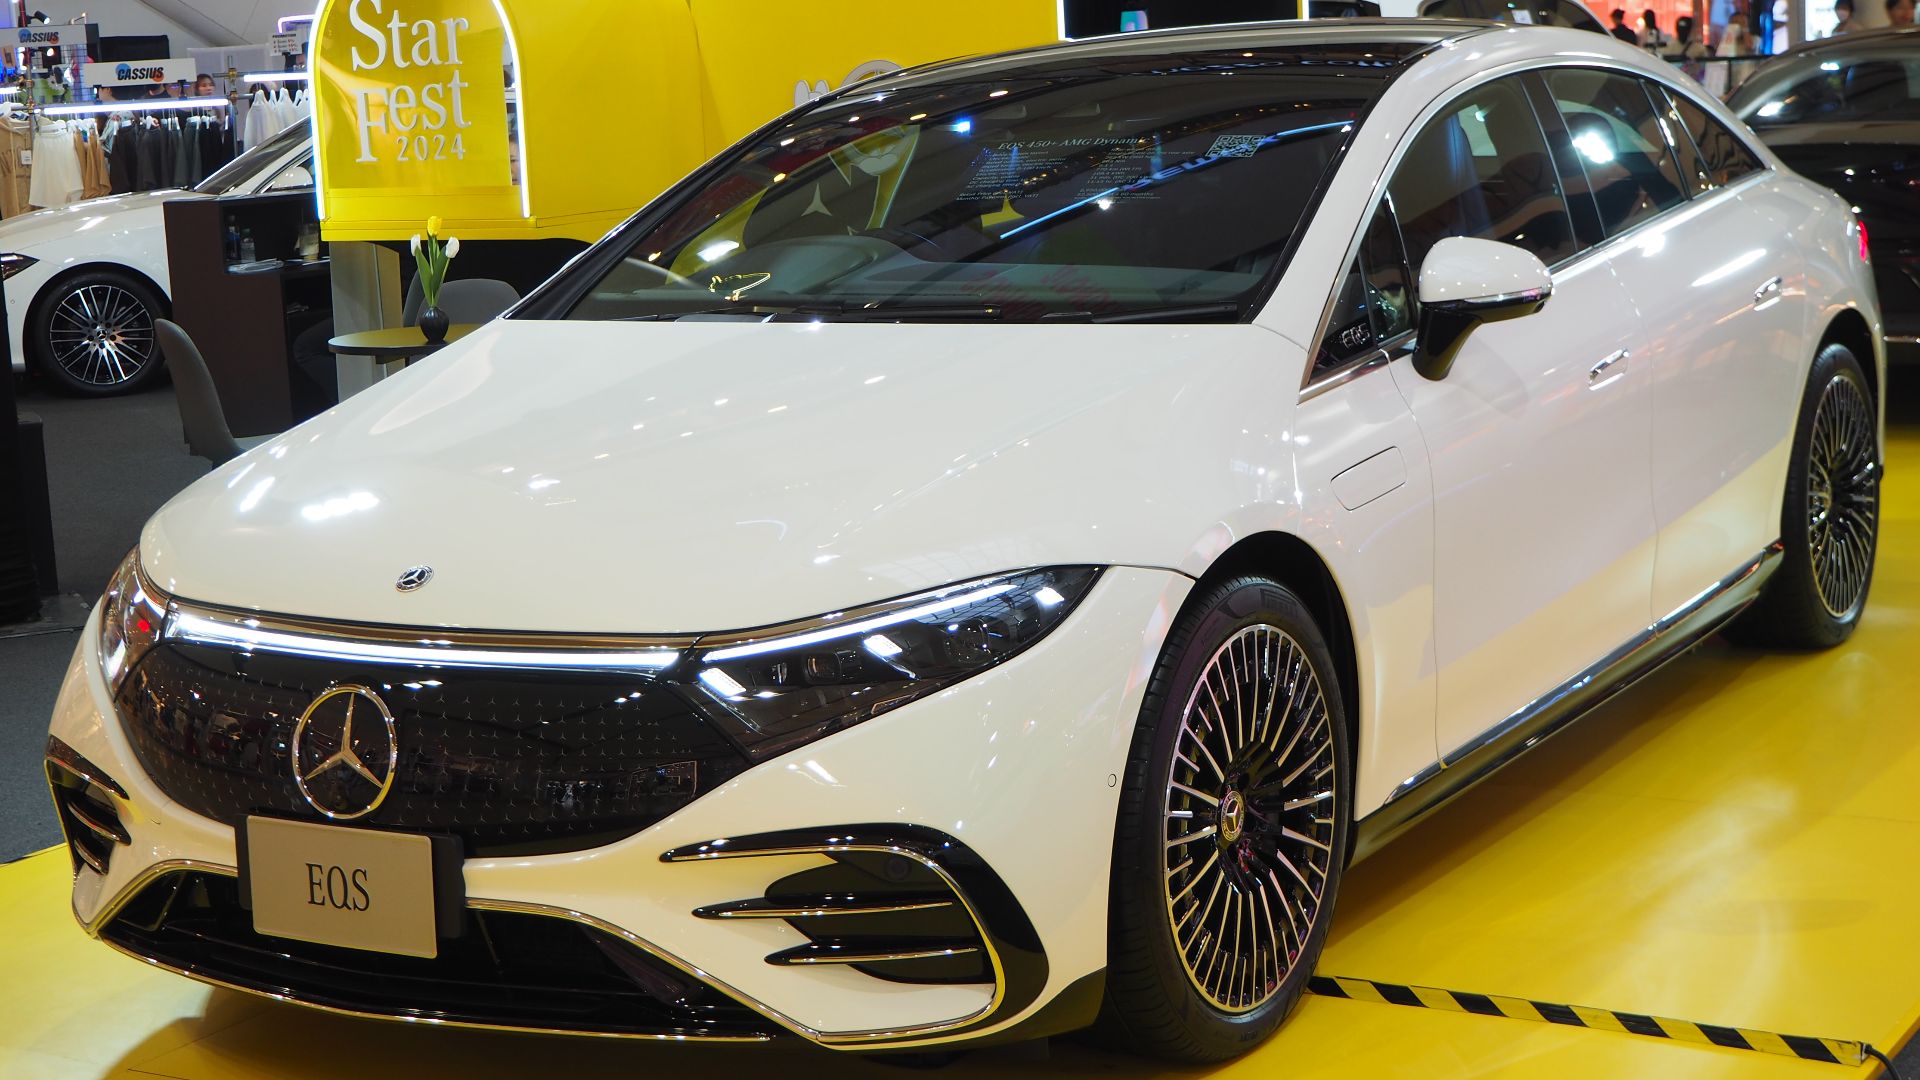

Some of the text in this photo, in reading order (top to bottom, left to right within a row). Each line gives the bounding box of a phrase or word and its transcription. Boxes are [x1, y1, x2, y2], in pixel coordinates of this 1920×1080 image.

[19, 31, 59, 44] CASSIUS
[349, 0, 469, 71] Star
[117, 66, 164, 81] CASSIUS
[351, 69, 472, 163] Fest
[396, 133, 466, 162] 2024
[1060, 138, 1091, 146] AMG
[304, 862, 370, 912] EQS
